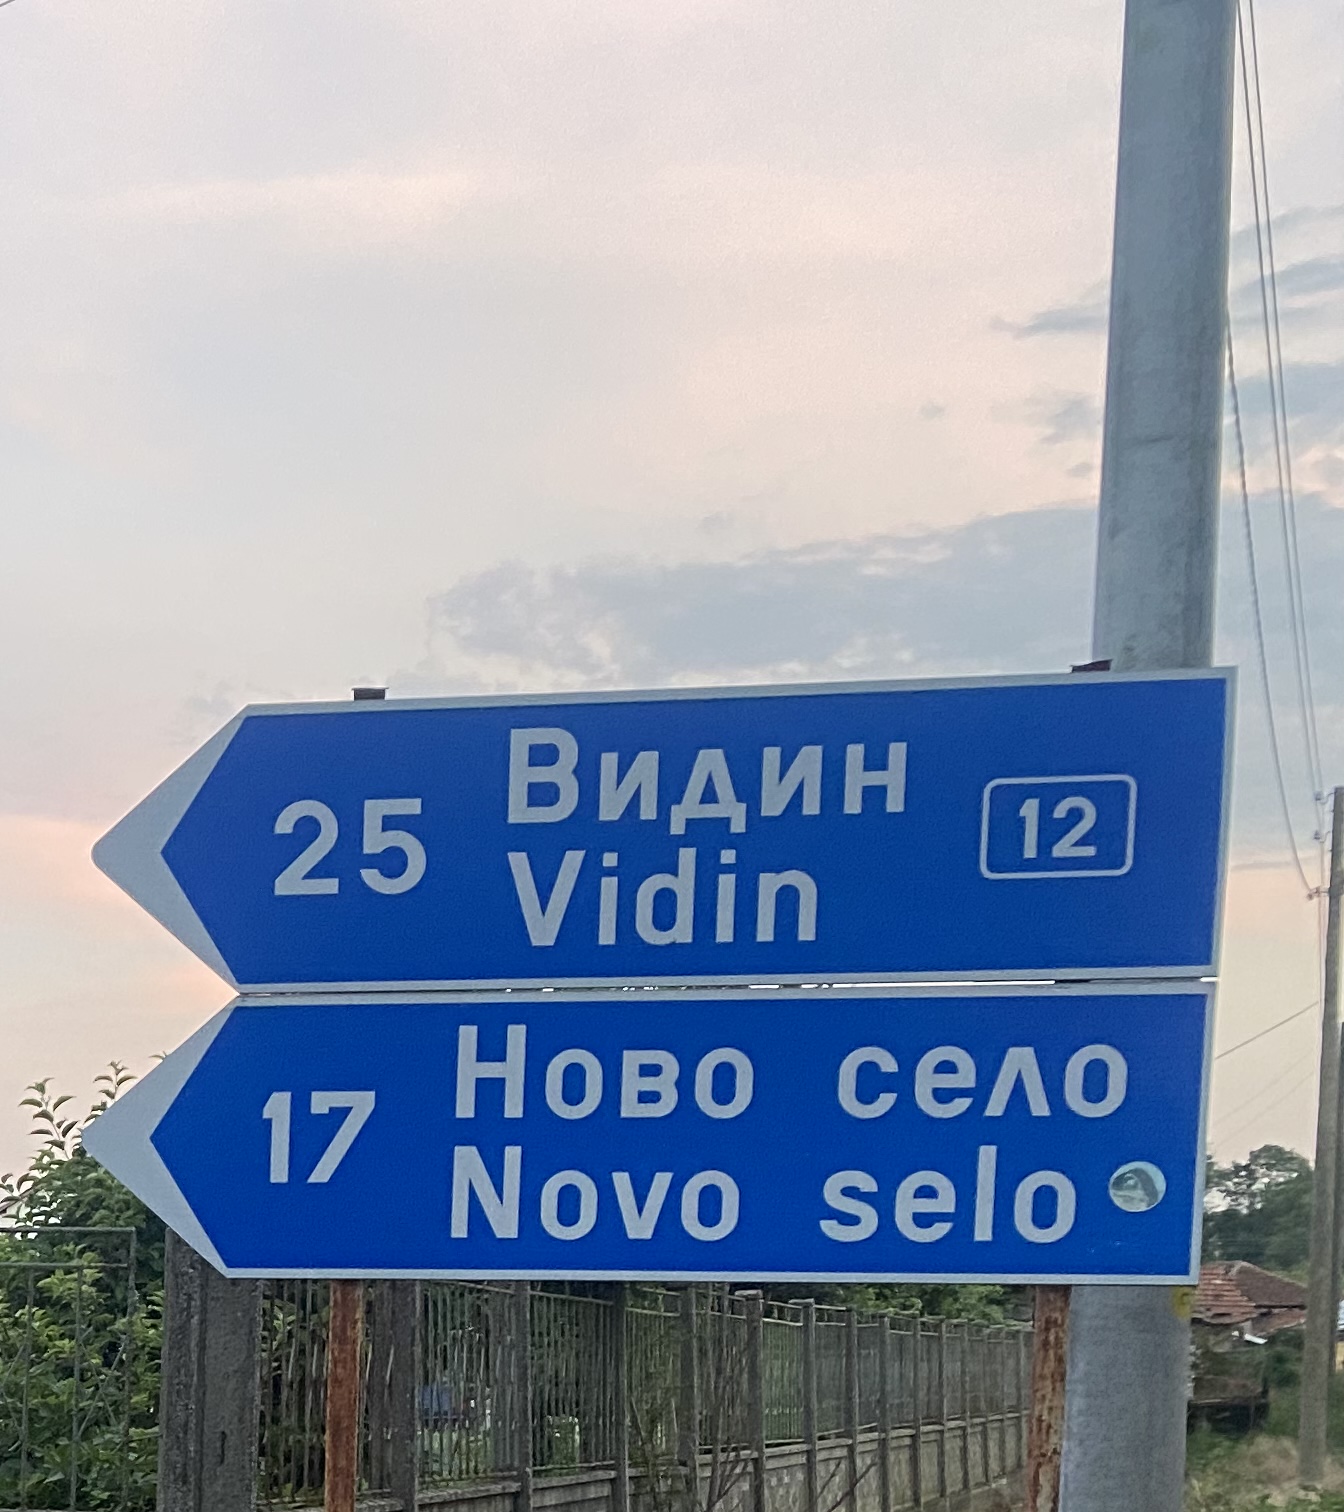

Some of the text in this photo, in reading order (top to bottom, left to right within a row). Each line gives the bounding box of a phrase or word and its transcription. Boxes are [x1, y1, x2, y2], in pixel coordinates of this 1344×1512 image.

[506, 727, 908, 835] Видин
[1019, 796, 1097, 859] 12
[274, 797, 427, 896] 25
[507, 847, 818, 947] Vidin
[455, 1023, 1128, 1120] Ново село
[262, 1090, 376, 1184] 17
[450, 1144, 1077, 1244] Novo selo
